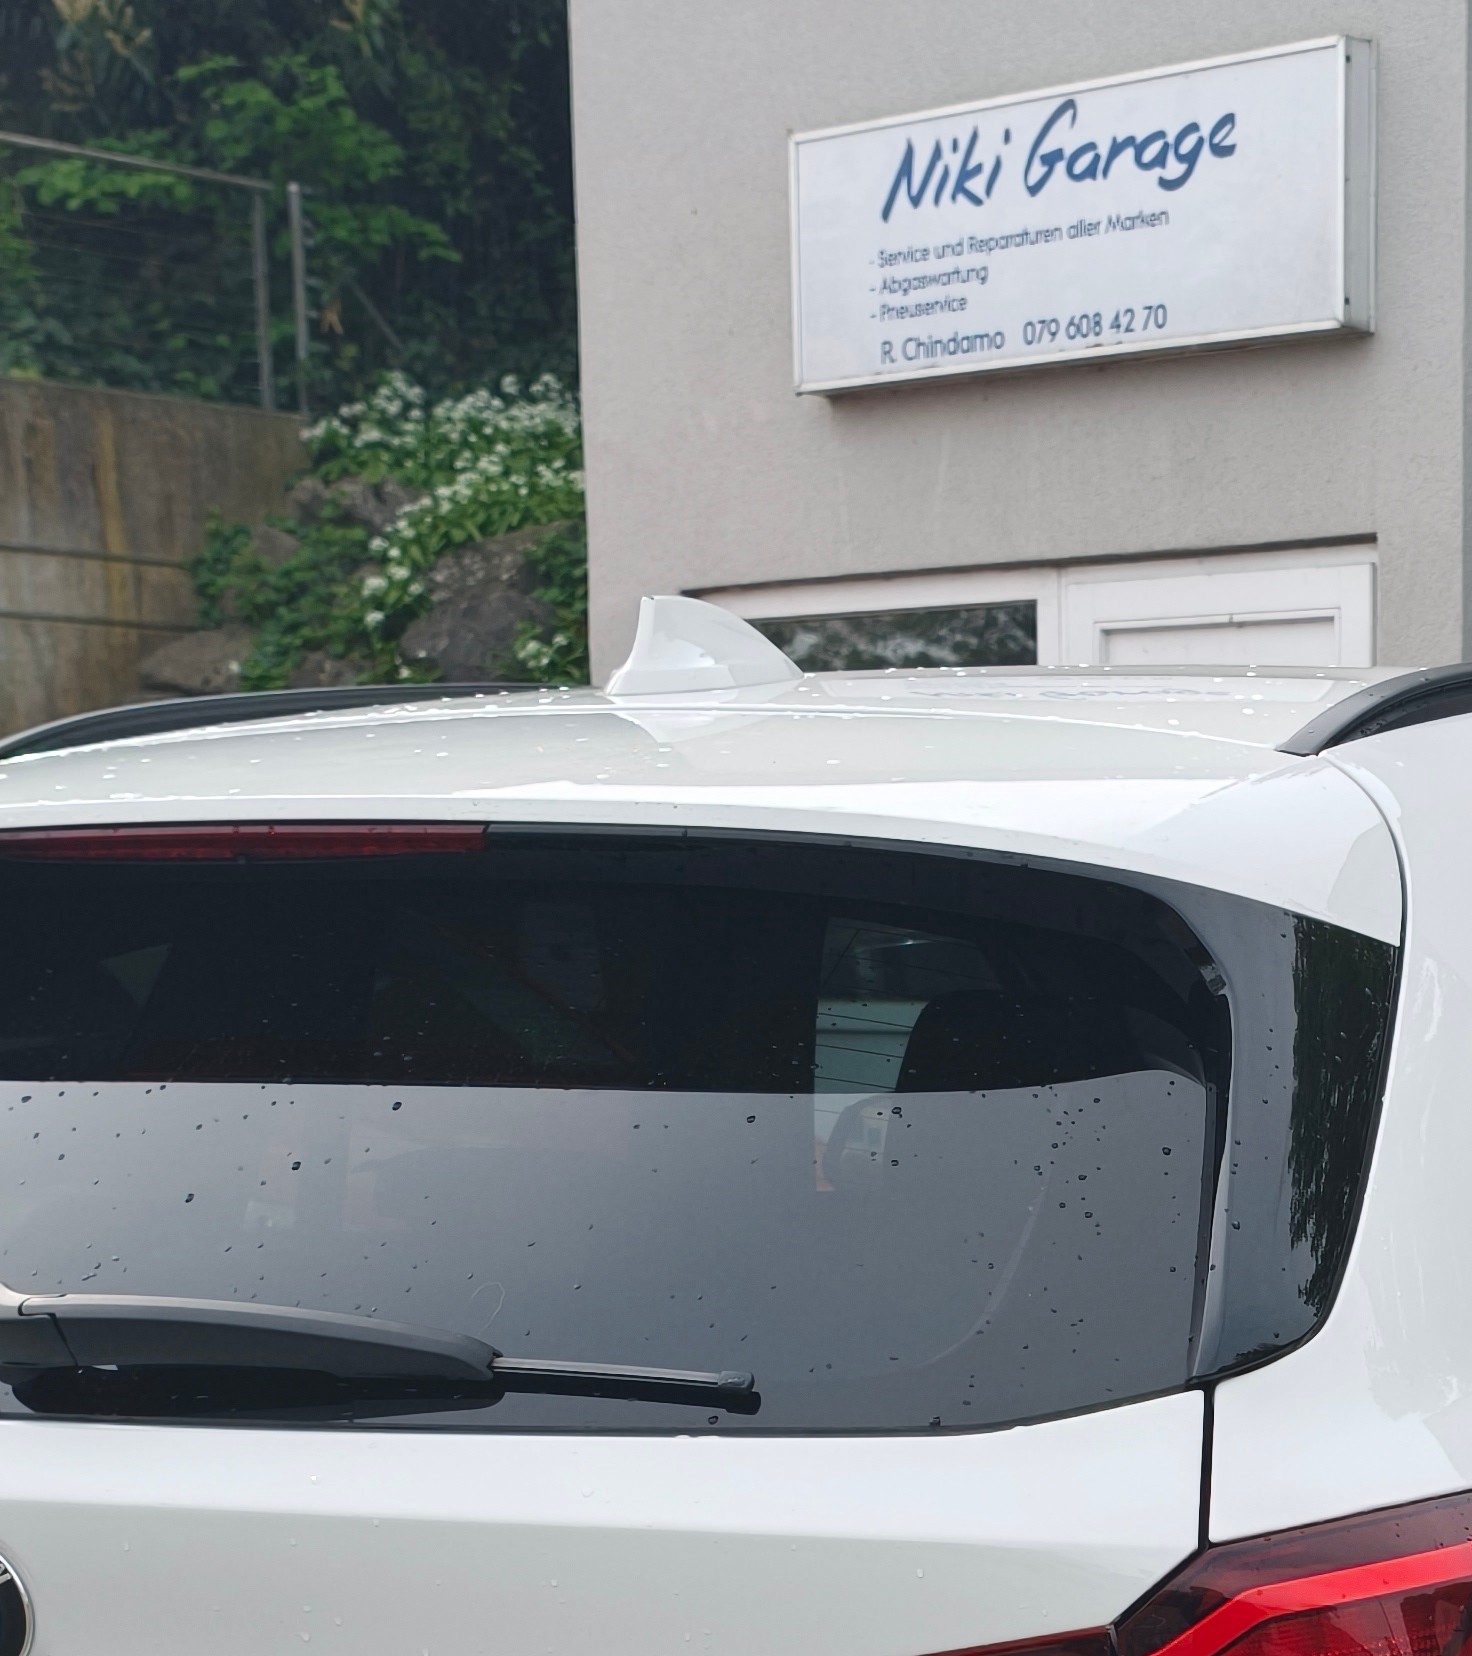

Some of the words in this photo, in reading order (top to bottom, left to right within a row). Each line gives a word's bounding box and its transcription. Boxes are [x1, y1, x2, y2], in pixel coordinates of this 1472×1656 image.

[882, 125, 1012, 223] Niki
[1023, 98, 1238, 197] Garage
[877, 245, 930, 268] Service
[933, 238, 965, 260] und
[967, 225, 1063, 256] Reparaturen
[1066, 217, 1102, 240] aller
[1104, 209, 1170, 236] Marken
[878, 265, 989, 296] Abgaswartung
[879, 295, 968, 322] Pneuservice
[901, 330, 1006, 361] Chindamo
[1023, 318, 1060, 345] 079
[1065, 311, 1103, 341] 608
[1109, 307, 1136, 334] 42
[1142, 303, 1168, 331] 70
